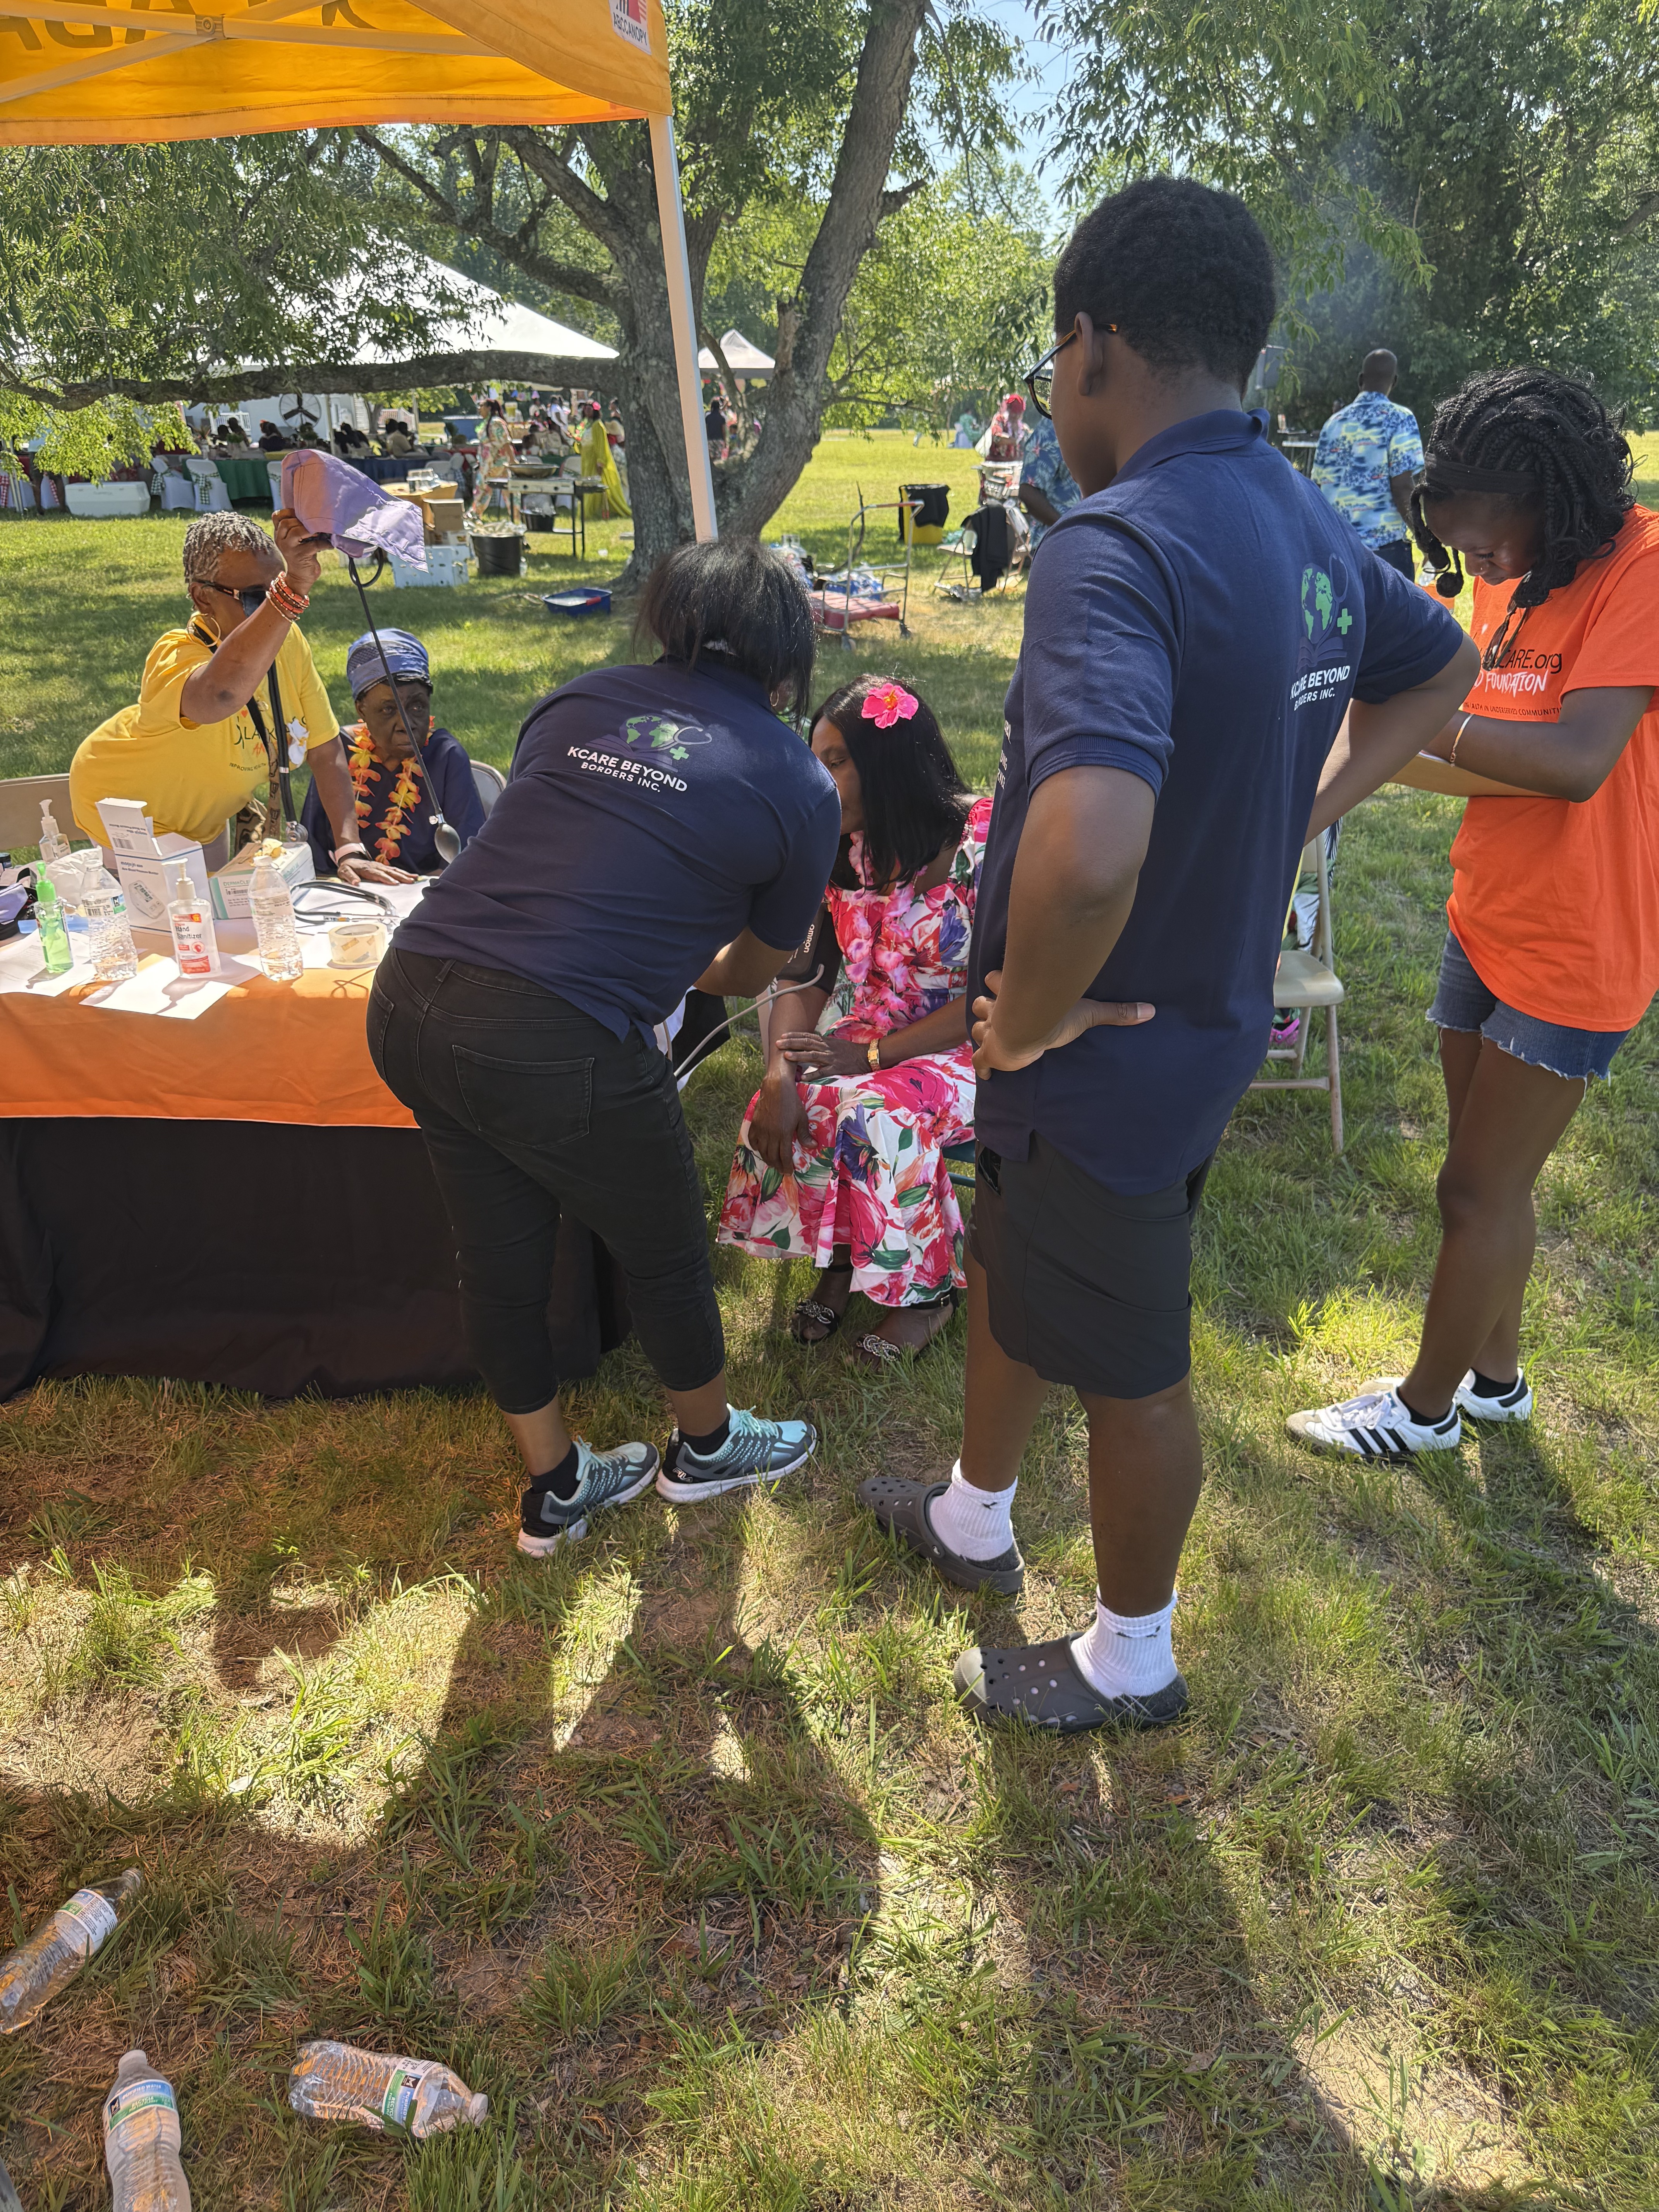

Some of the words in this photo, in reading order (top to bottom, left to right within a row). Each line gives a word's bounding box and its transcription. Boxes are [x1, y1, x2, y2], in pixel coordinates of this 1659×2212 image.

[613, 12, 647, 46] ABCCANOPY
[1307, 665, 1350, 688] BEYOND
[1485, 669, 1549, 698] FOUNDATION
[1319, 687, 1335, 700] INC.
[567, 746, 619, 768] KCARE
[620, 760, 687, 792] BEYOND
[581, 761, 634, 782] BORDERS
[637, 777, 660, 793] INC.
[804, 924, 815, 953] omron
